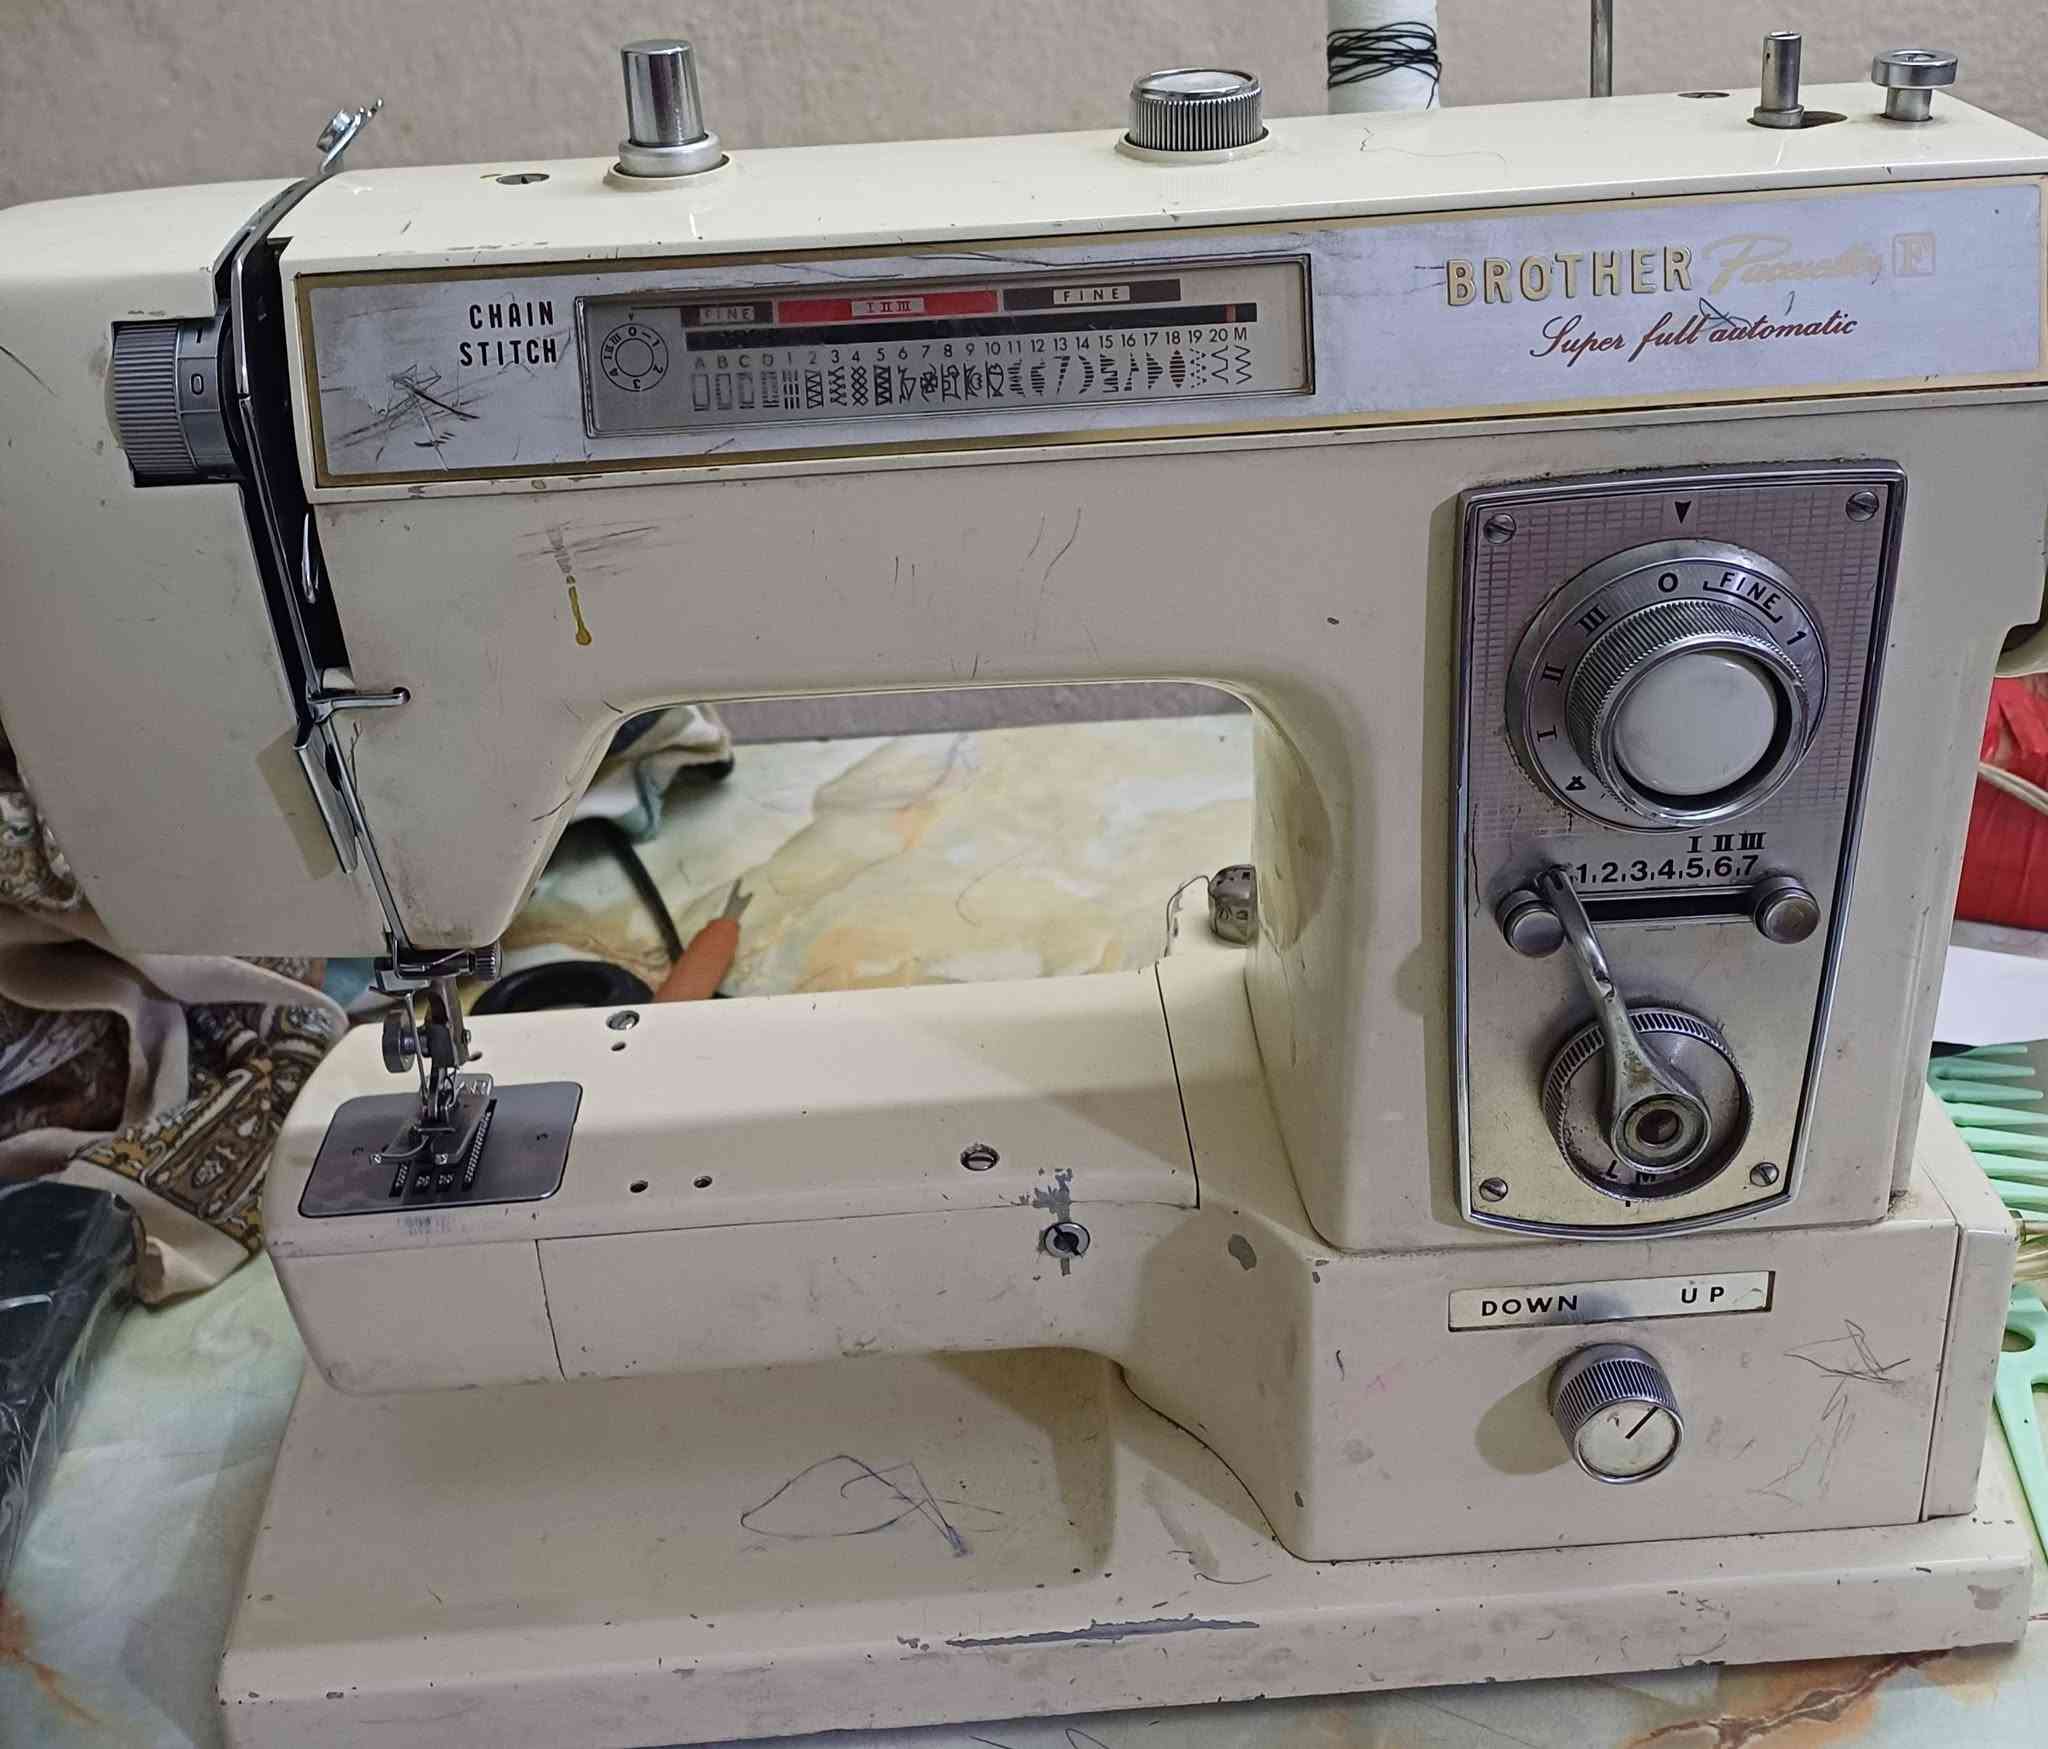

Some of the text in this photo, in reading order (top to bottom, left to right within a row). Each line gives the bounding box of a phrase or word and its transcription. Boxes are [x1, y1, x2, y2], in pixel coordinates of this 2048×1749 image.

[1446, 244, 1692, 307] BROTHER
[1062, 287, 1120, 302] FINE
[469, 301, 555, 329] CHAIN
[704, 306, 752, 321] FINE
[459, 339, 557, 366] STITCH
[717, 354, 728, 368] B
[738, 354, 749, 367] C
[809, 351, 816, 364] 2
[831, 350, 839, 363] 3
[852, 350, 860, 362] 4
[877, 348, 885, 361] 5
[898, 347, 907, 360] 6
[922, 345, 930, 358] 7
[944, 344, 953, 357] 8
[966, 343, 974, 356] 9
[985, 342, 1000, 355] 10
[1008, 341, 1021, 354] 11
[1031, 339, 1045, 352] 12
[1054, 337, 1068, 351] 13
[1075, 336, 1089, 350] 14
[1099, 335, 1113, 349] 15
[1121, 333, 1135, 347] 16
[1144, 332, 1158, 346] 17
[1166, 330, 1181, 345] 18
[1188, 329, 1202, 344] 19
[1209, 328, 1228, 343] 20
[1234, 326, 1248, 341] M
[1530, 310, 1858, 367] Super full automatic
[1719, 571, 1782, 610] FINE
[1481, 1286, 1725, 1317] DOWN UP
